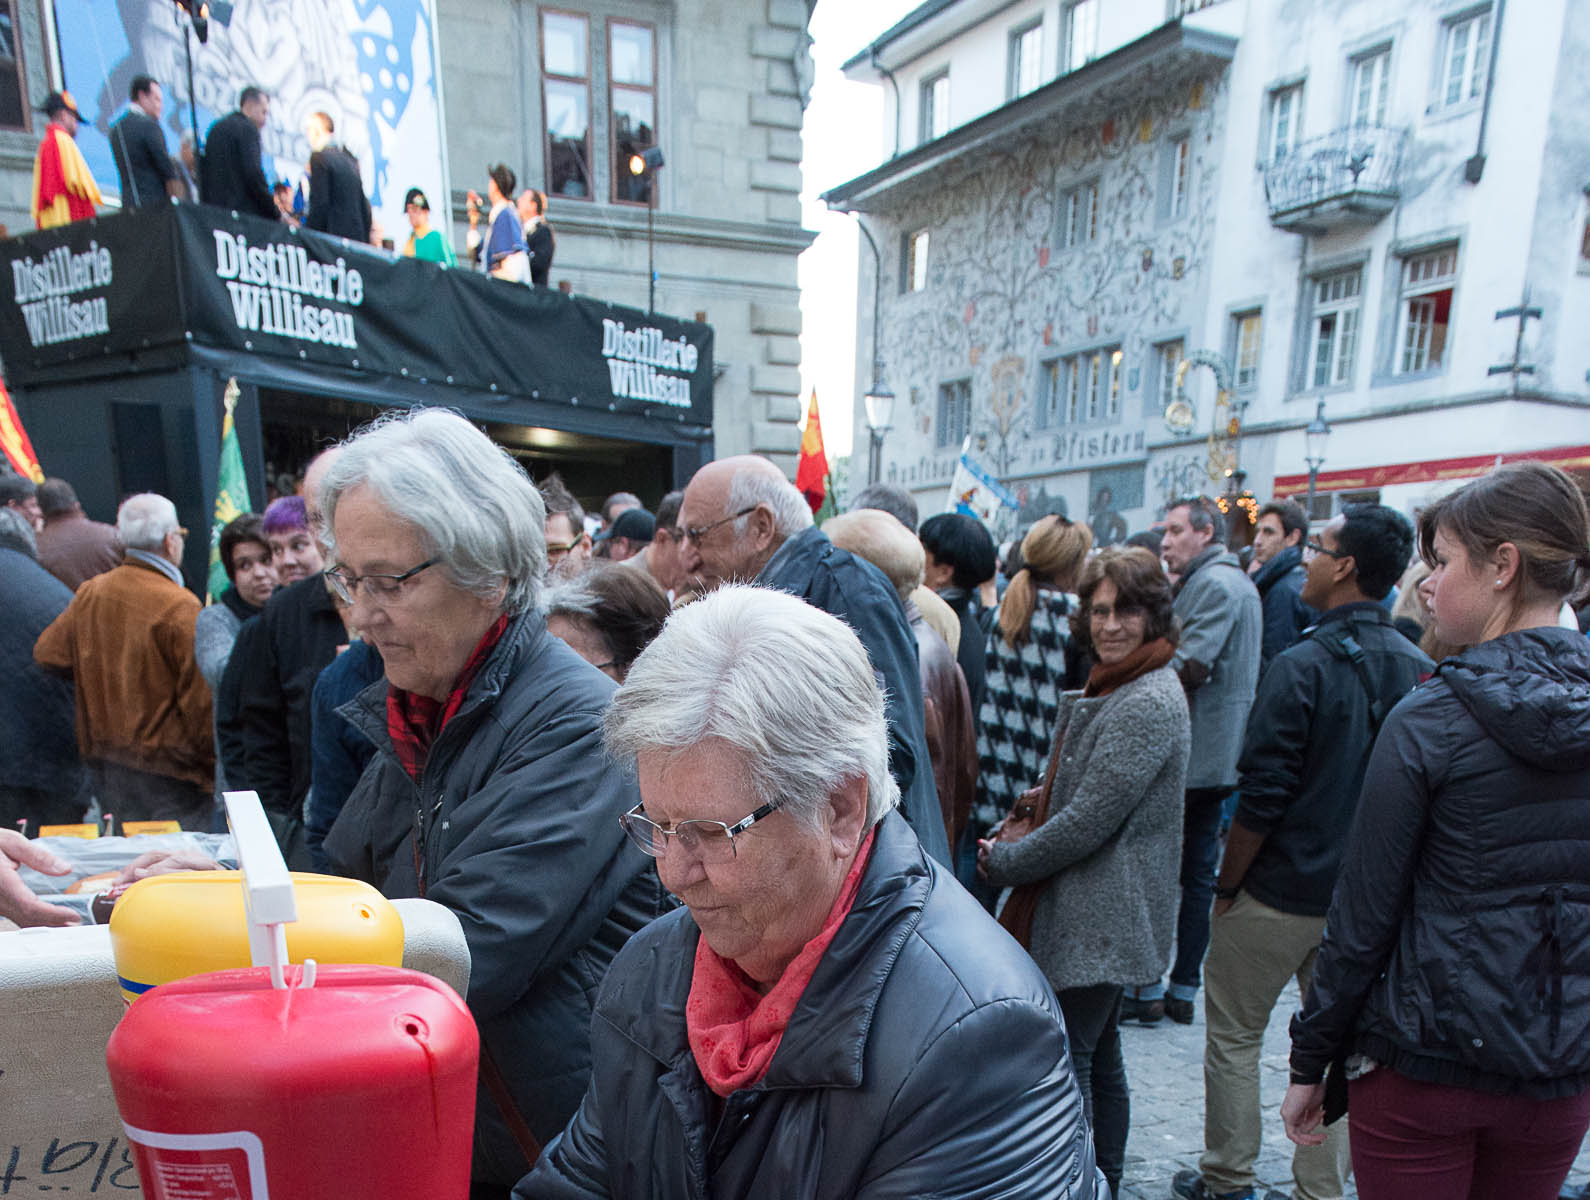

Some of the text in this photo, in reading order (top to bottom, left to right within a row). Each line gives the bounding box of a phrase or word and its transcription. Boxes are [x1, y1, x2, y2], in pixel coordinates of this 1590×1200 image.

[11, 240, 112, 304] Distillerie
[214, 229, 364, 306] Distillerie
[22, 296, 110, 347] Willisau
[226, 281, 358, 349] Willisau
[602, 318, 698, 373] Distillerie
[607, 358, 692, 408] Willisau
